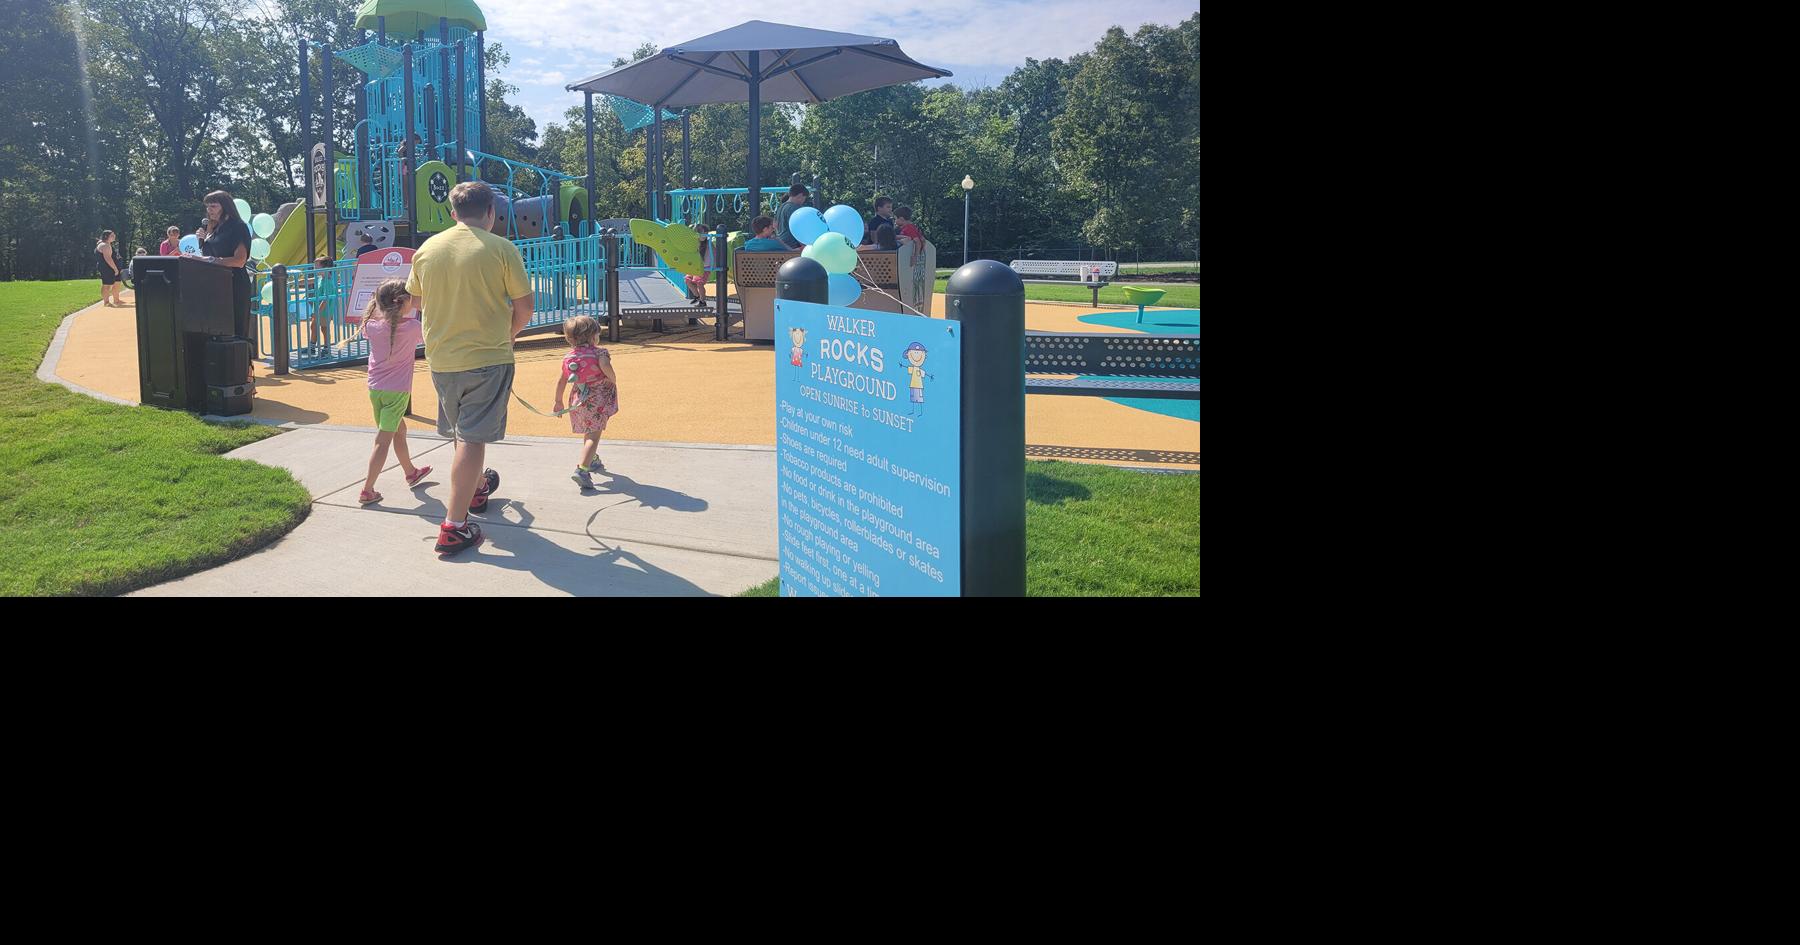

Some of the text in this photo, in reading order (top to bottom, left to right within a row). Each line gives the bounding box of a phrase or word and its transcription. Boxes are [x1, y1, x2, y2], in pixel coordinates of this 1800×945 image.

[827, 314, 876, 338] WALKER
[820, 338, 884, 373] ROCKS
[811, 362, 897, 401] PLAYGROUND
[796, 407, 804, 418] at
[804, 411, 820, 424] your
[821, 417, 837, 431] own
[838, 422, 853, 438] risk
[800, 384, 914, 433] OPEN SUNRISE to SUNSET
[803, 444, 816, 457] are
[816, 450, 848, 472] required
[809, 430, 831, 446] under
[833, 437, 843, 452] 12
[843, 444, 865, 461] need
[866, 454, 889, 472] adult
[891, 464, 951, 496] supervision
[793, 470, 809, 487] food
[809, 481, 818, 491] or
[818, 484, 836, 501] drink
[837, 492, 845, 508] in
[846, 499, 861, 516] the
[861, 508, 913, 545] playground
[915, 538, 940, 559] area
[810, 464, 842, 488] products
[843, 481, 857, 495] are
[858, 488, 903, 519] prohibited
[788, 501, 800, 515] the
[799, 509, 840, 541] playground
[840, 533, 859, 553] area
[843, 517, 894, 555] rollerblades
[896, 548, 906, 560] or
[909, 554, 944, 582] skates
[794, 522, 814, 542] rough
[814, 535, 841, 563] playing
[842, 553, 852, 565] or
[853, 561, 880, 588] yelling
[795, 555, 821, 583] walking
[821, 574, 832, 589] up
[801, 540, 815, 561] feet
[832, 564, 848, 583] one
[849, 575, 858, 590] at
[859, 583, 866, 594] a
[867, 586, 880, 597] tim
